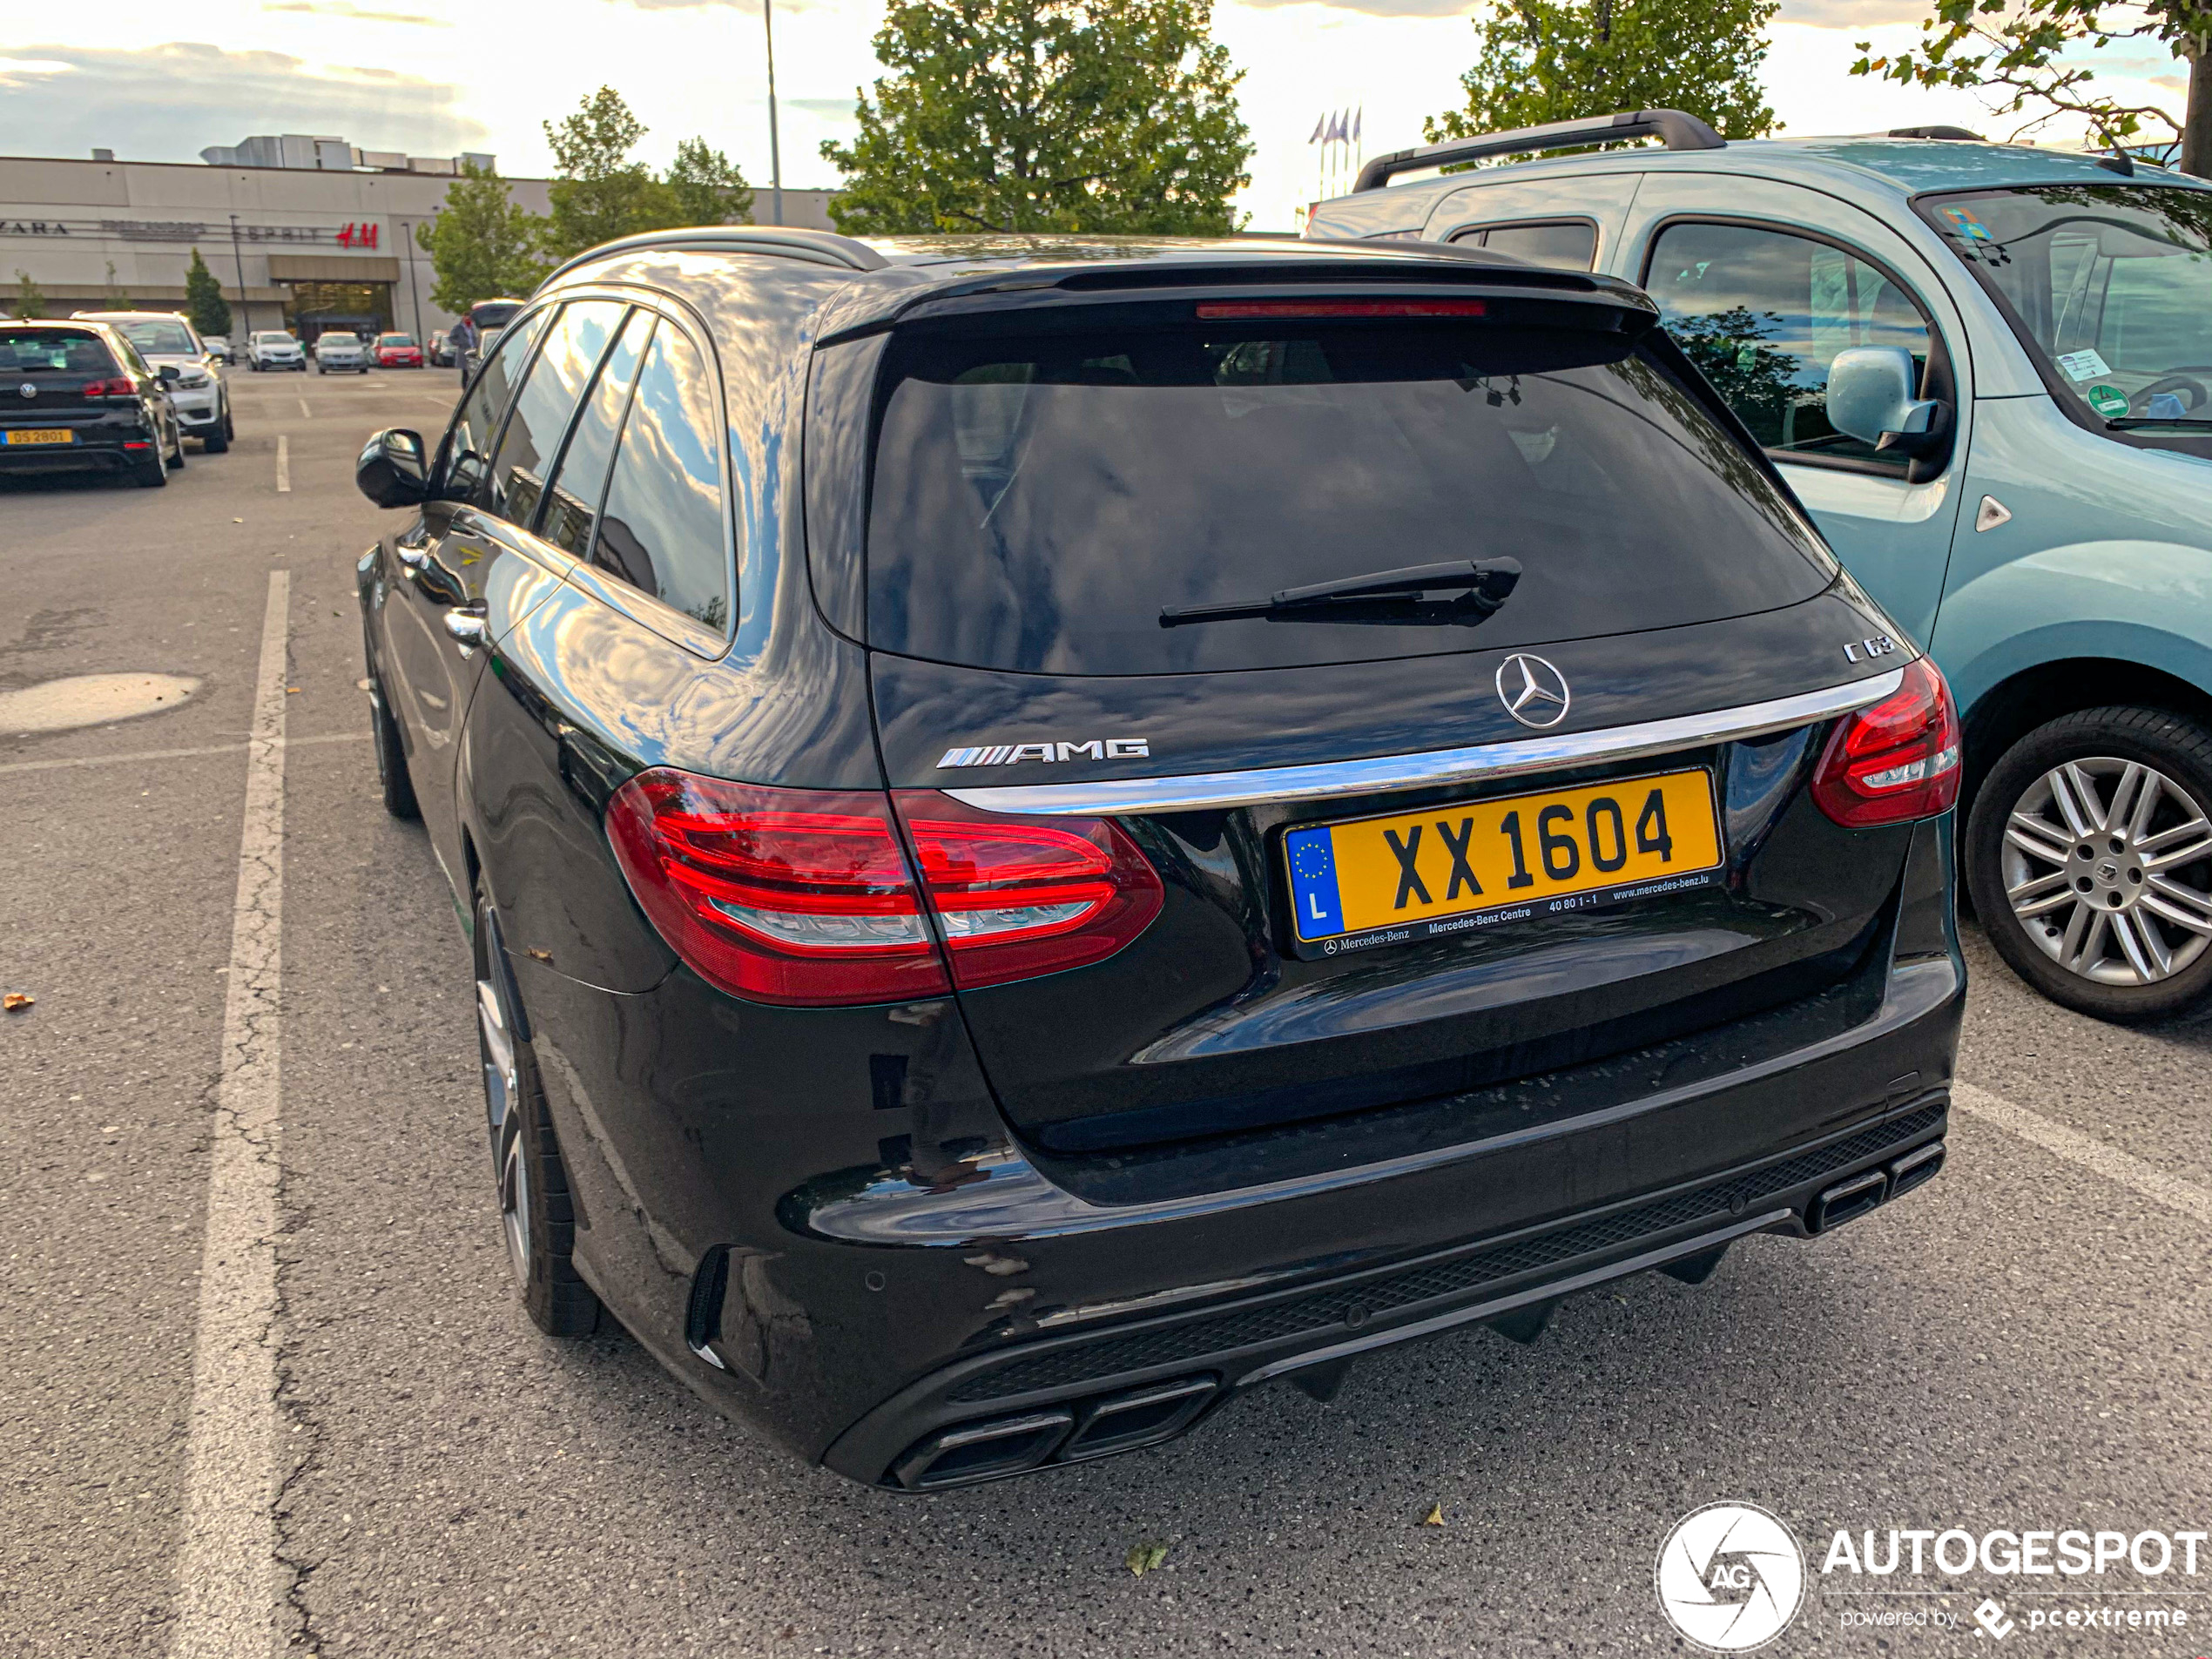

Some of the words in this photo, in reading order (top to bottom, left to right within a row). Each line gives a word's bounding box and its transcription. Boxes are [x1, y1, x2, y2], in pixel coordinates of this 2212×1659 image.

[34, 431, 64, 442] 2801
[1843, 643, 1864, 664] C
[1383, 818, 1483, 909] XX
[1501, 789, 1673, 889] 1604
[1309, 893, 1327, 919] L
[1340, 929, 1409, 950] Mercedes-Benz
[1429, 915, 1499, 934] Mercedes-Benz
[1501, 908, 1531, 921] Centre
[1613, 874, 1709, 900] www.mercedes-benz.lu
